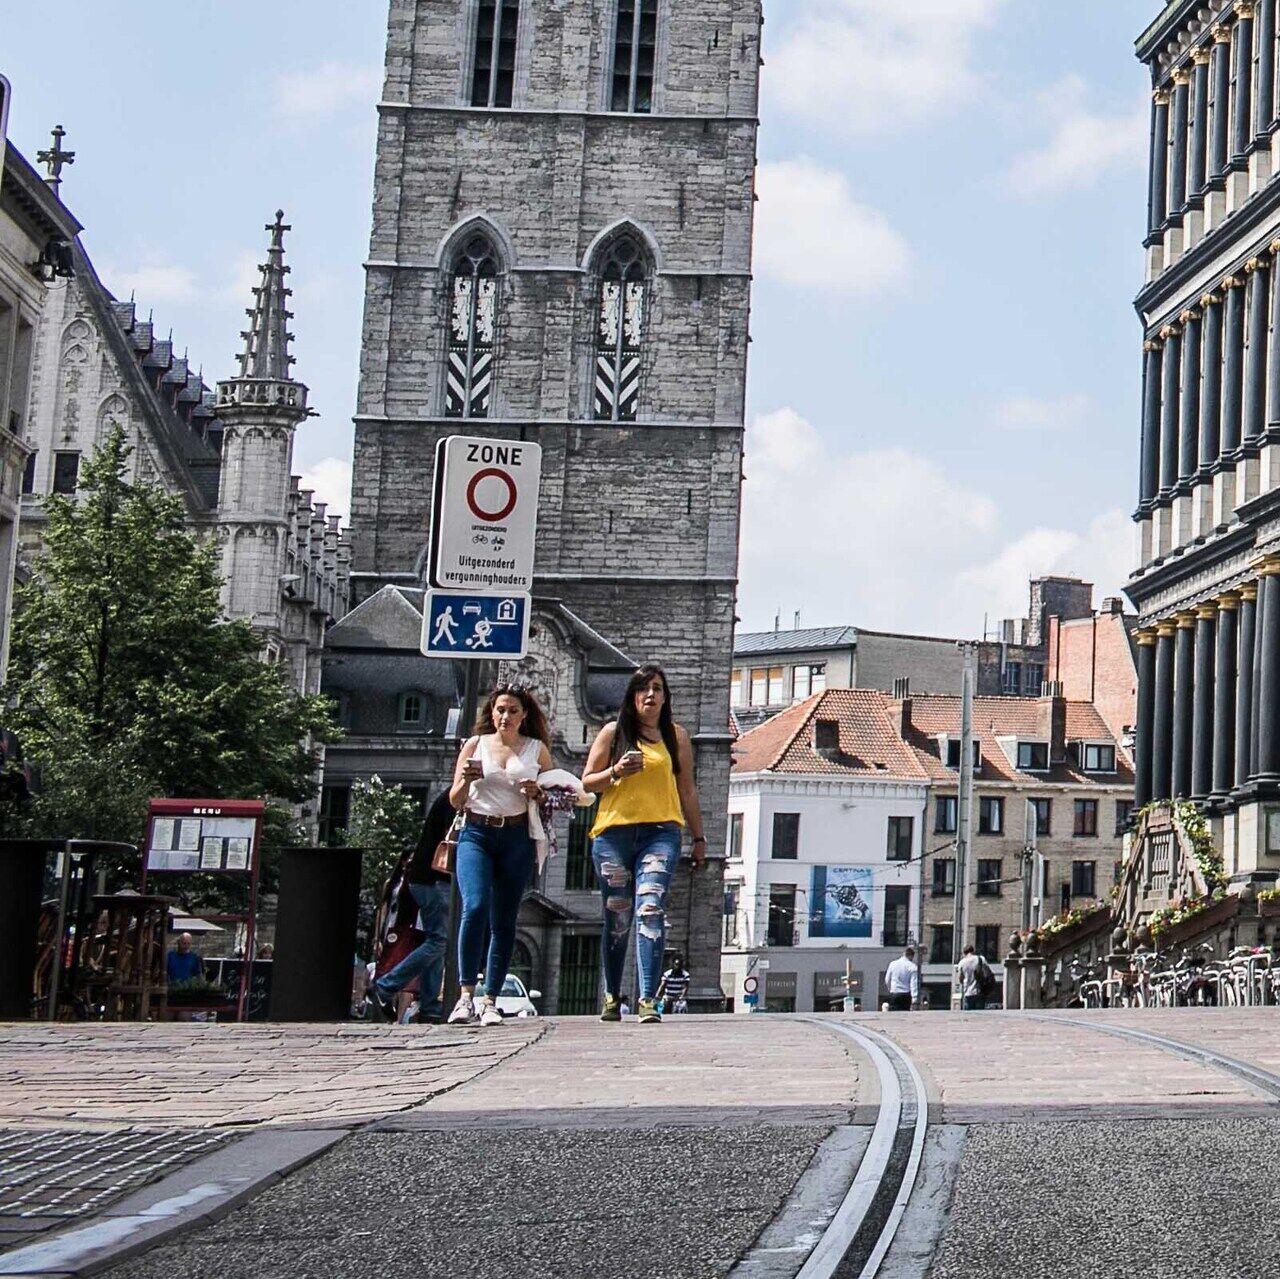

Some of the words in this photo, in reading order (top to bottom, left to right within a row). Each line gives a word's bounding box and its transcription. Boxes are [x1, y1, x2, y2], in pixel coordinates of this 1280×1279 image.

[467, 444, 523, 466] ZONE
[458, 555, 516, 570] Uitgezonderd
[445, 572, 527, 585] vergunninghouders
